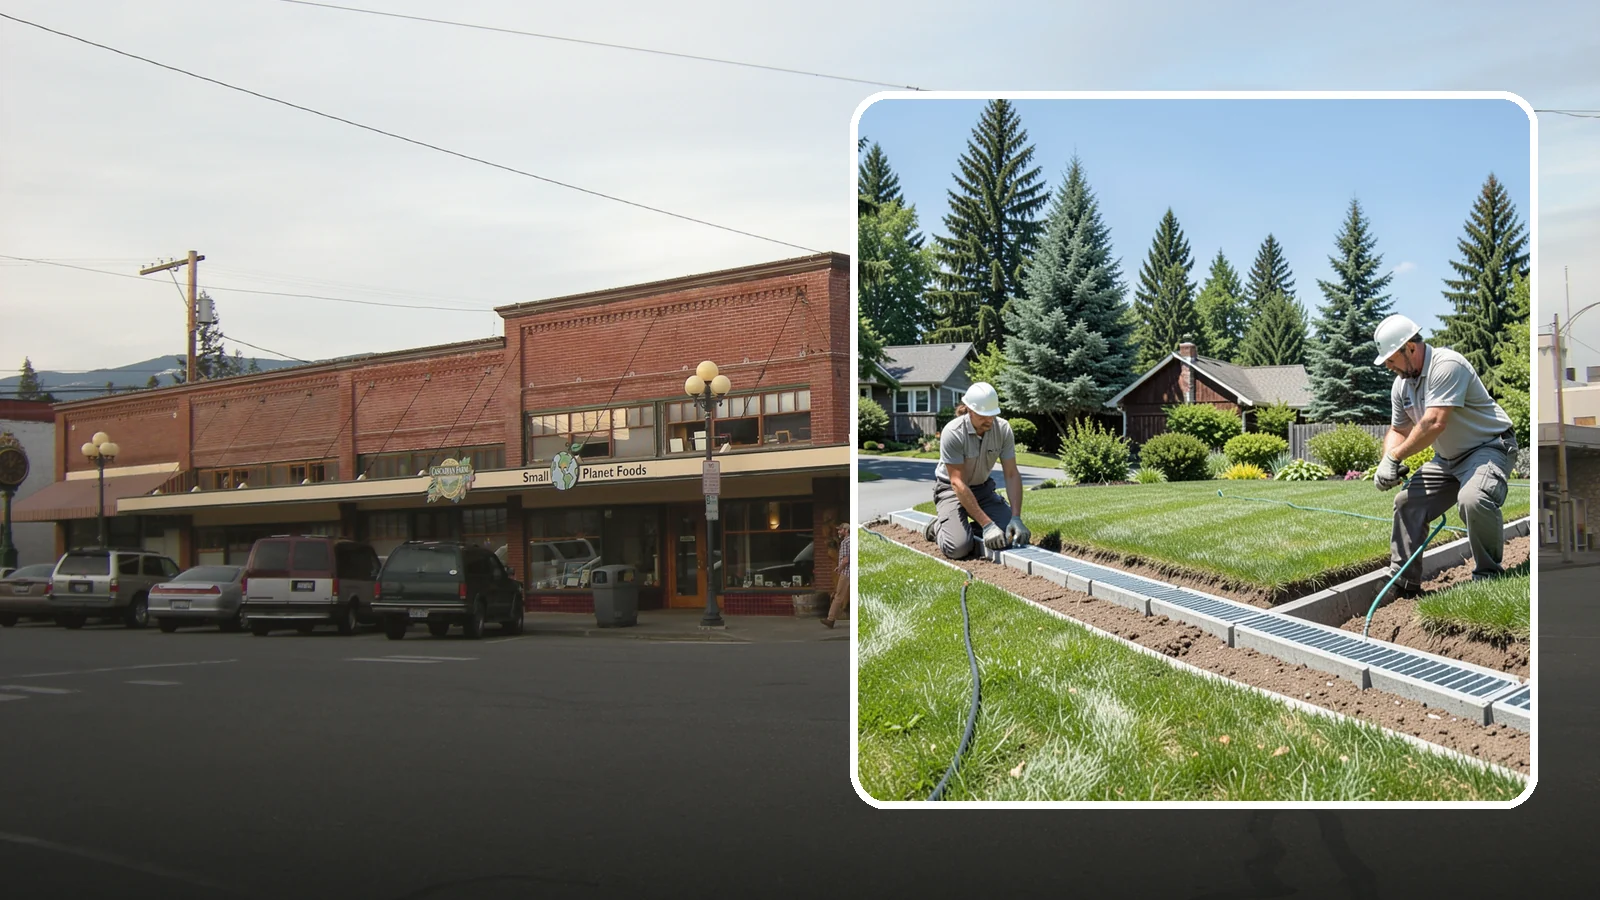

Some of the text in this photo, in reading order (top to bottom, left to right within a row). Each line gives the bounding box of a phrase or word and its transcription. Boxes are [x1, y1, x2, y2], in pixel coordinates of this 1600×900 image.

[523, 464, 647, 483] Small Planet Foods
